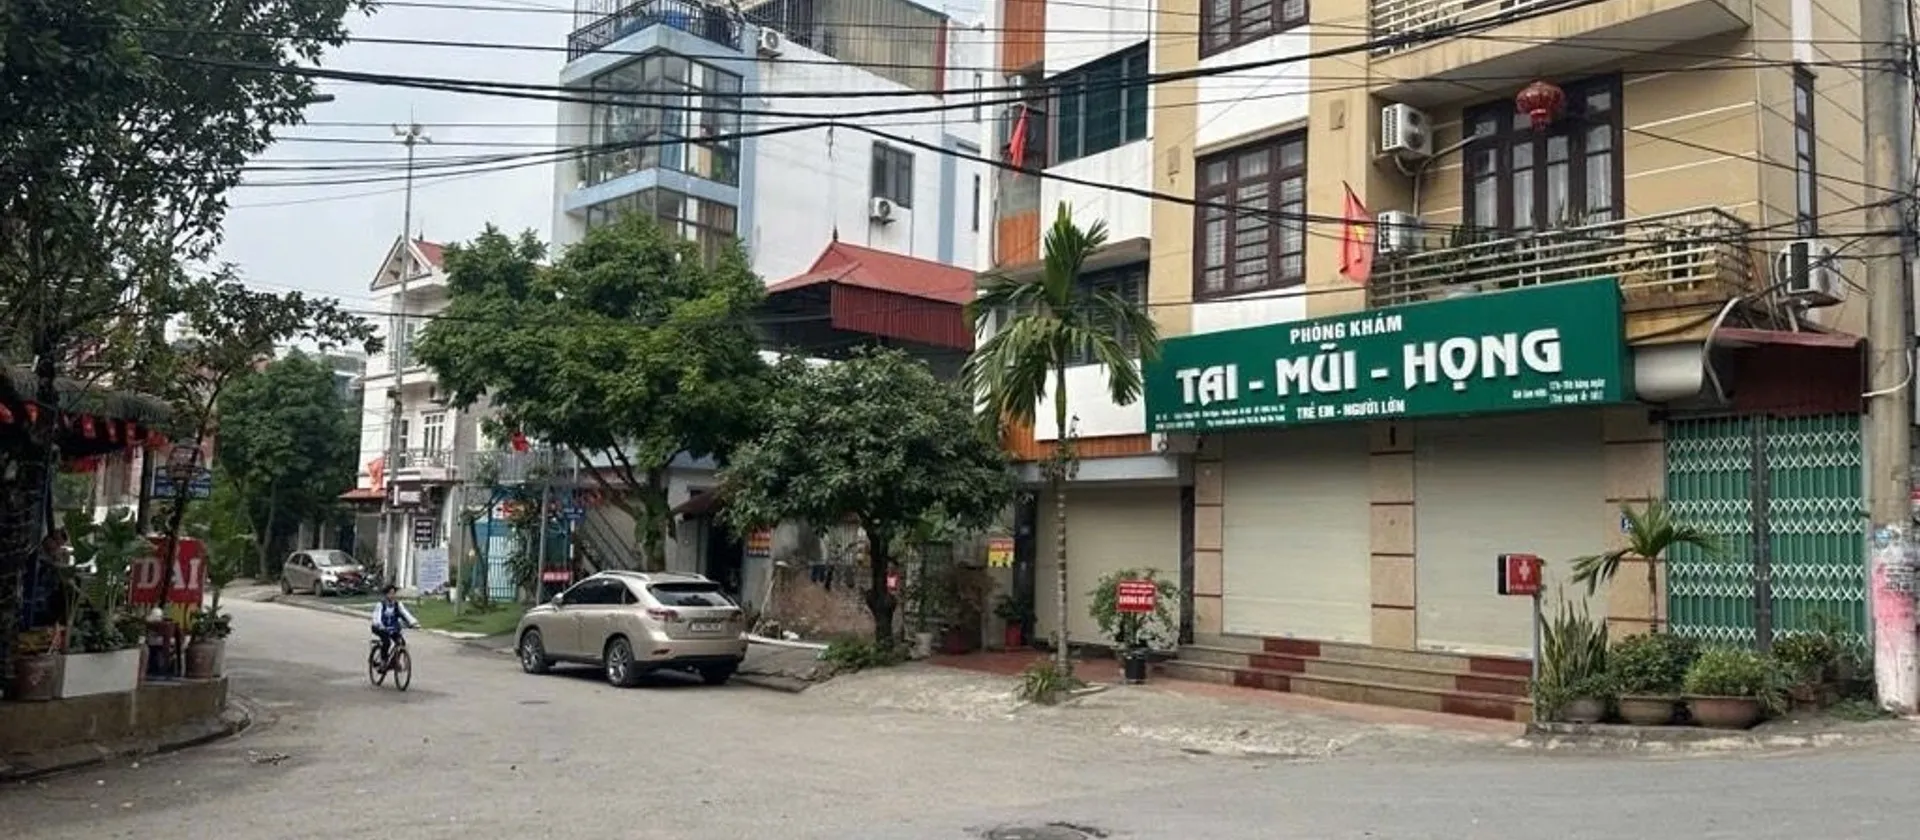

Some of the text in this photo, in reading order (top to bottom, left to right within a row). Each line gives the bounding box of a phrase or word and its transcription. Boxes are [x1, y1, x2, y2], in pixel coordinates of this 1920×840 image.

[1290, 312, 1402, 344] PHÒNG KHÁM
[1176, 365, 1238, 406] TAI
[1276, 343, 1357, 396] MŨI
[1404, 329, 1562, 392] HỌNG
[1296, 402, 1316, 419] TRẺ
[1318, 405, 1334, 418] EM
[1343, 399, 1378, 416] NGƯỜI
[1382, 397, 1405, 413] LỚN
